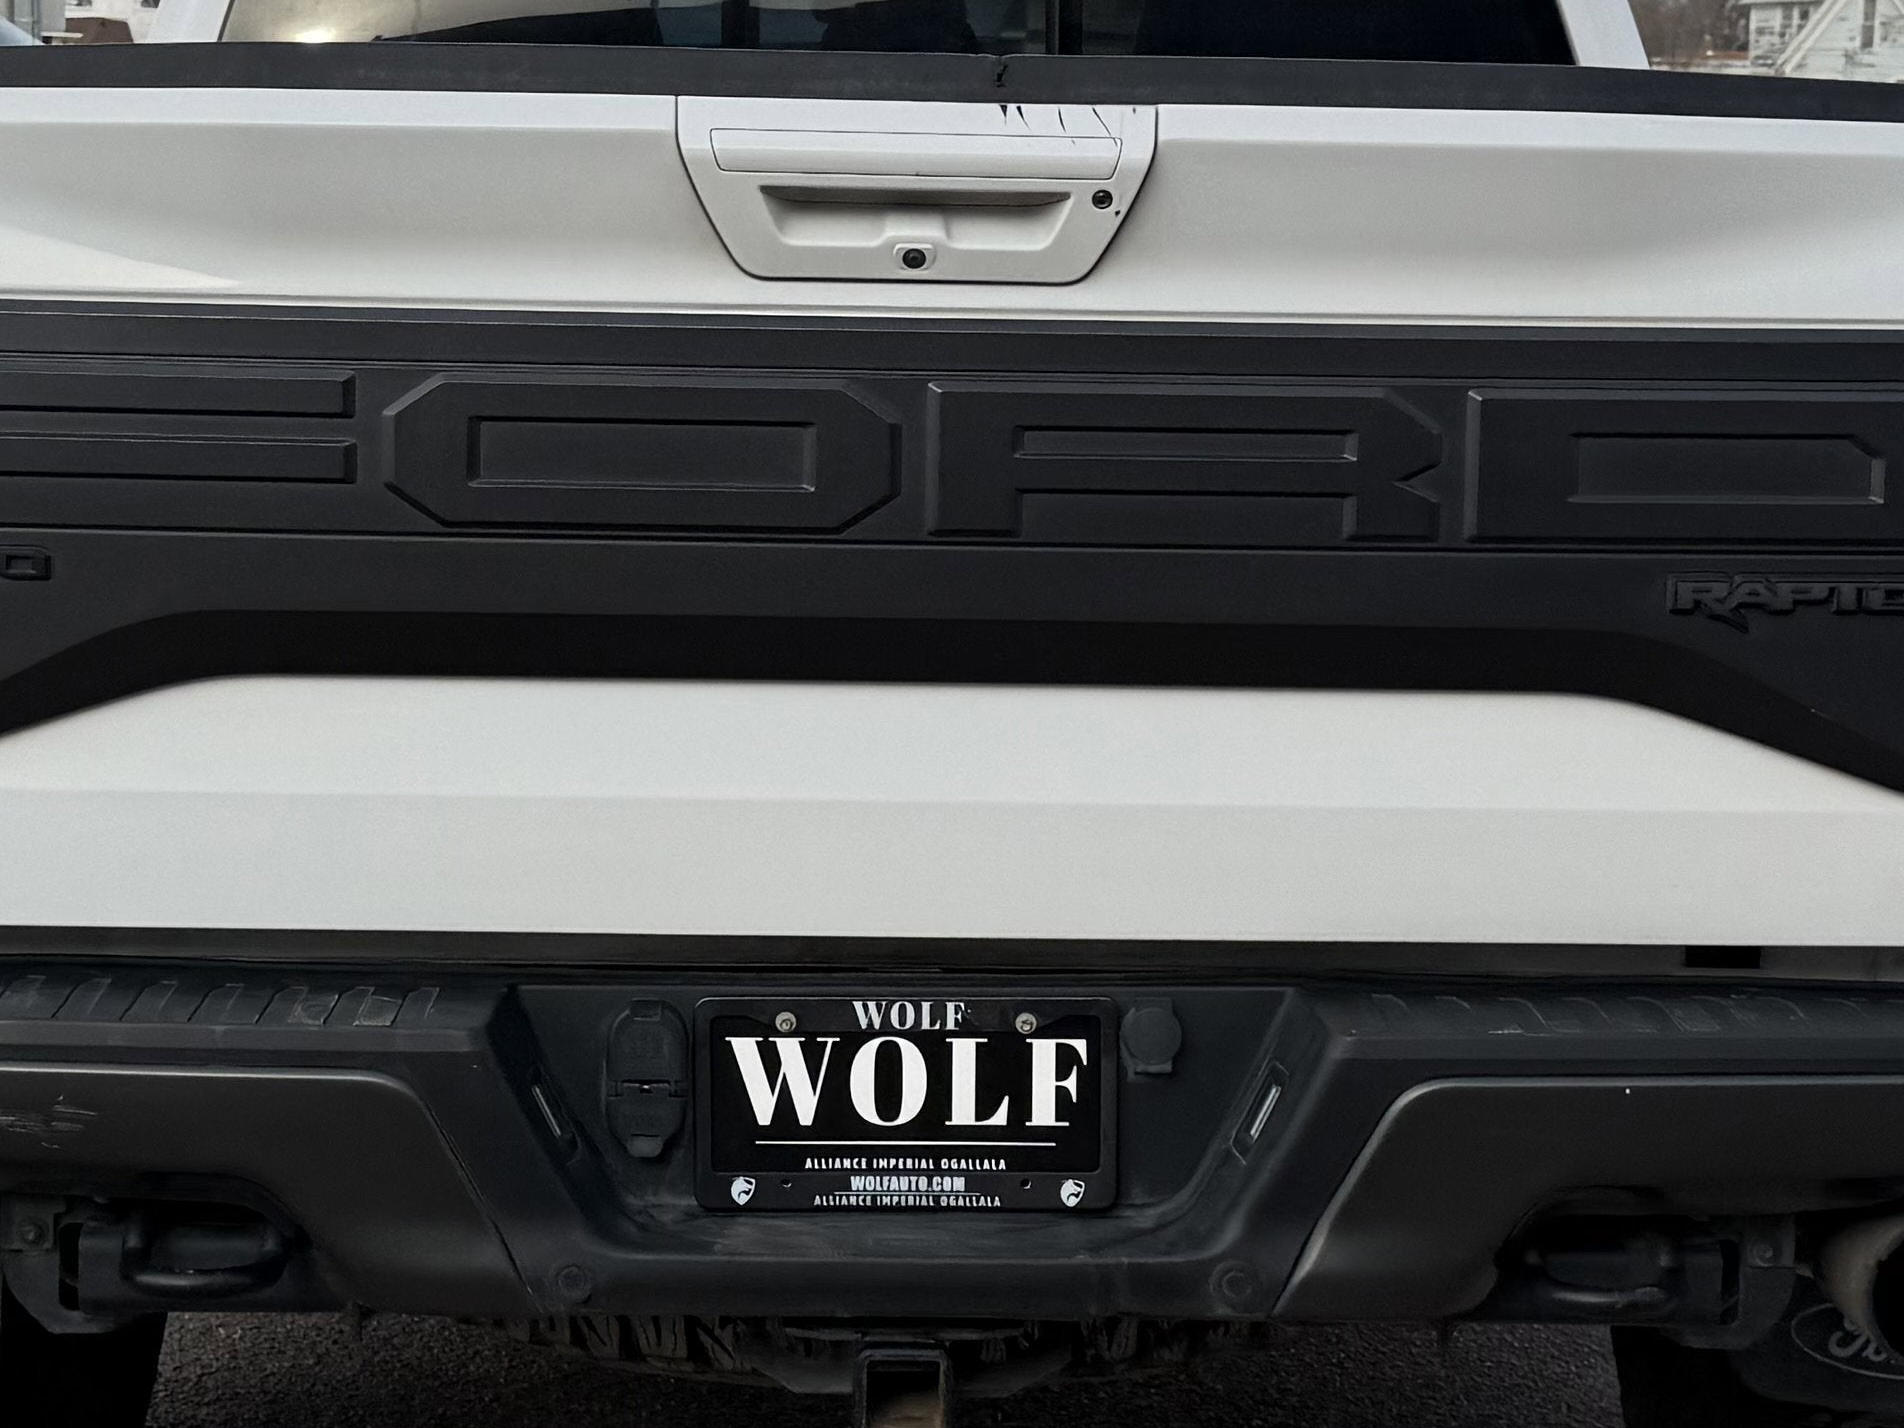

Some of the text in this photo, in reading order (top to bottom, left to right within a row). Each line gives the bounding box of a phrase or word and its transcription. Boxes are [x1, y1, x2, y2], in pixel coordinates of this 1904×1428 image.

[851, 1000, 967, 1031] WOLF
[725, 1035, 1088, 1128] WOLF
[804, 1157, 1006, 1171] ALLIANCE IMPERIAL OGALLALA
[850, 1175, 965, 1192] WOLFAUTO.COM
[813, 1195, 1001, 1207] ALLIANCE IMPERIAL OGALLALA
